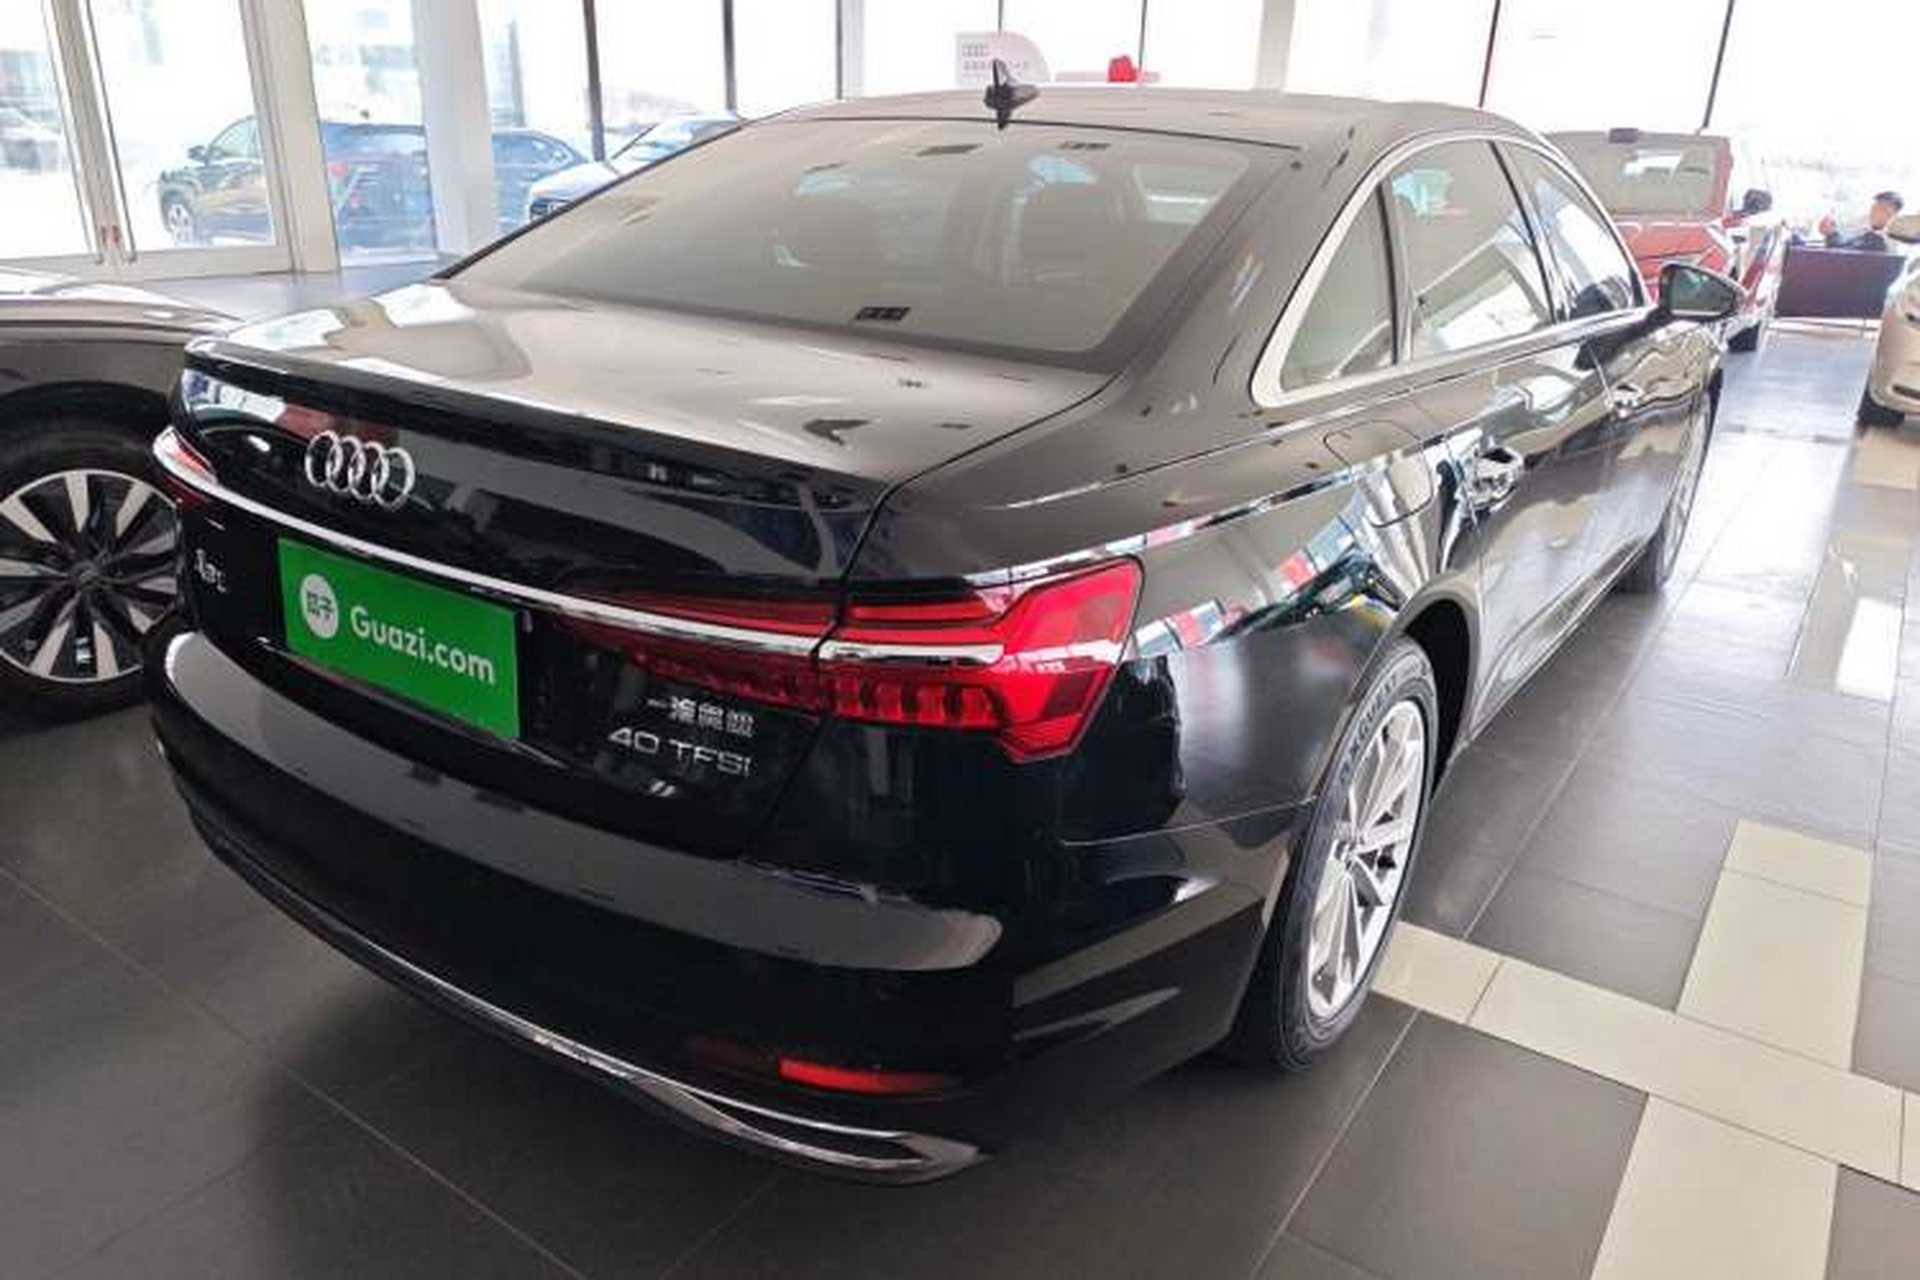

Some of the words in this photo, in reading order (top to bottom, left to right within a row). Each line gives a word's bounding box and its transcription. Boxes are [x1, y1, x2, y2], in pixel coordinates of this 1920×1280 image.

[351, 605, 495, 685] Guazi.com
[608, 727, 660, 754] 40
[669, 739, 751, 777] TFSI
